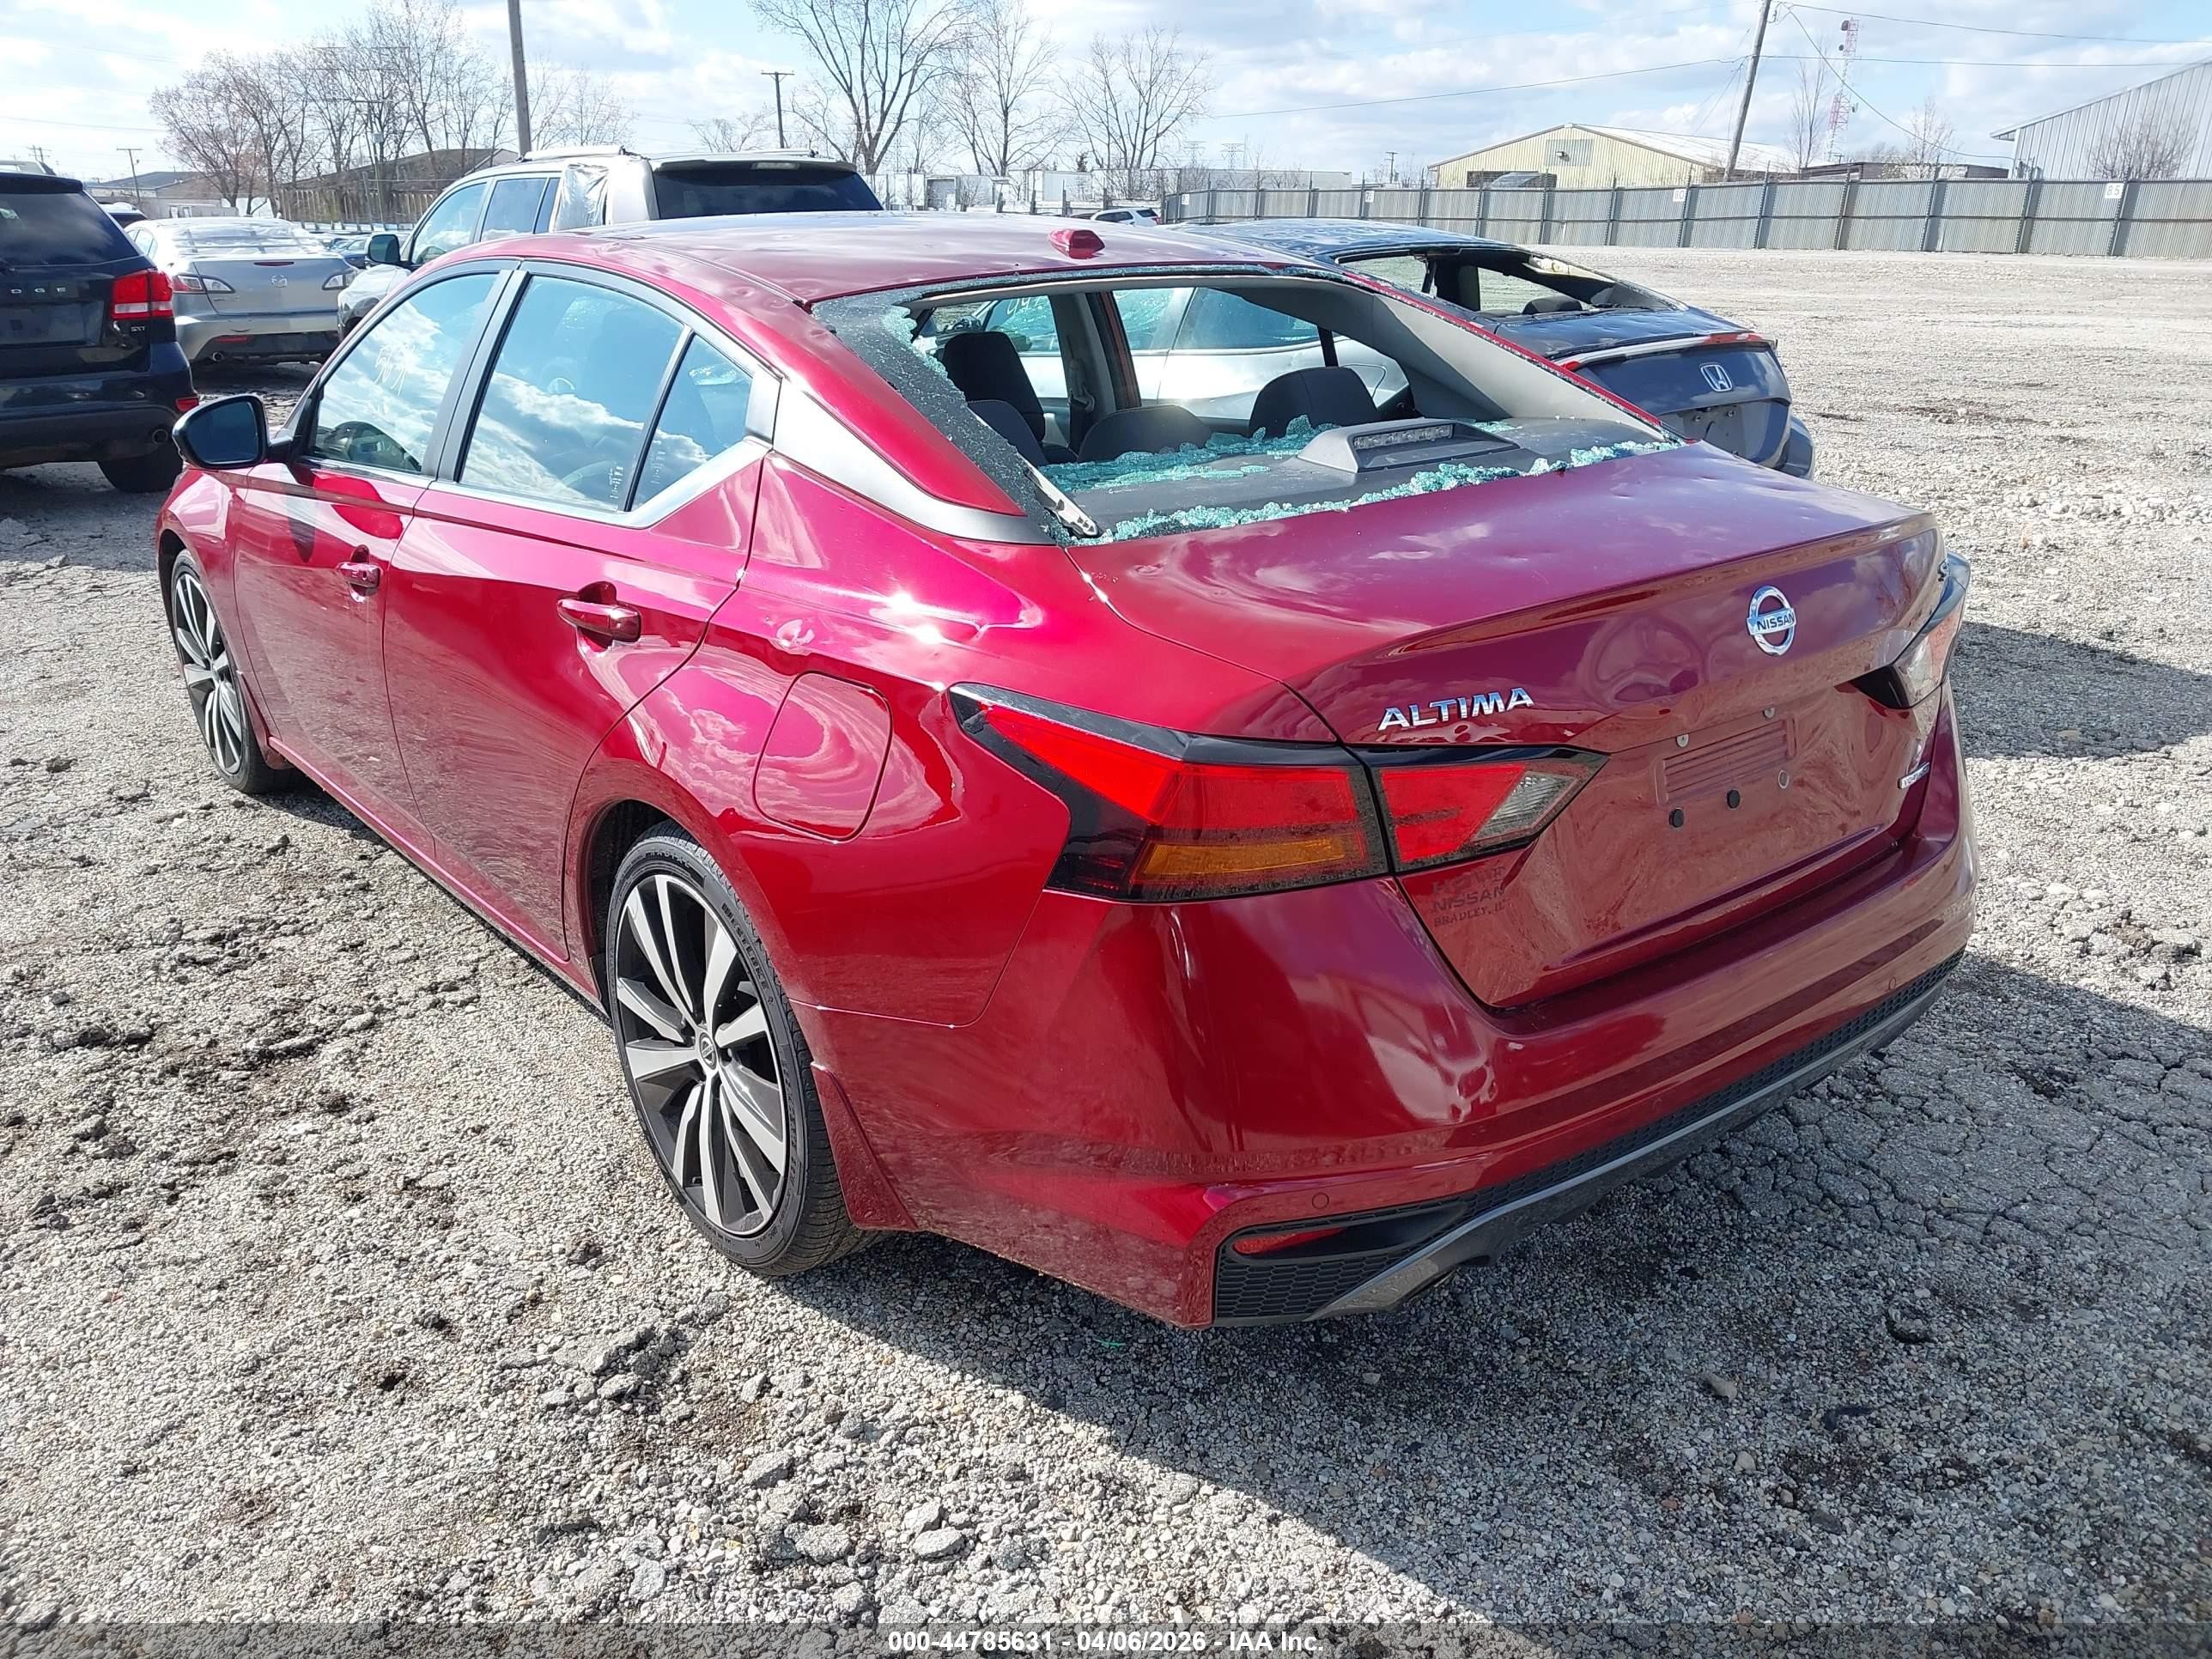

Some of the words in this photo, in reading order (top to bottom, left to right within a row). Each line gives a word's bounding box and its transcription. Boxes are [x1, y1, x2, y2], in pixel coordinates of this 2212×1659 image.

[2106, 185, 2122, 197] 85
[1756, 612, 1795, 631] NISSAN
[1377, 687, 1534, 731] ALTIMA
[1432, 885, 1506, 912] NISSAN
